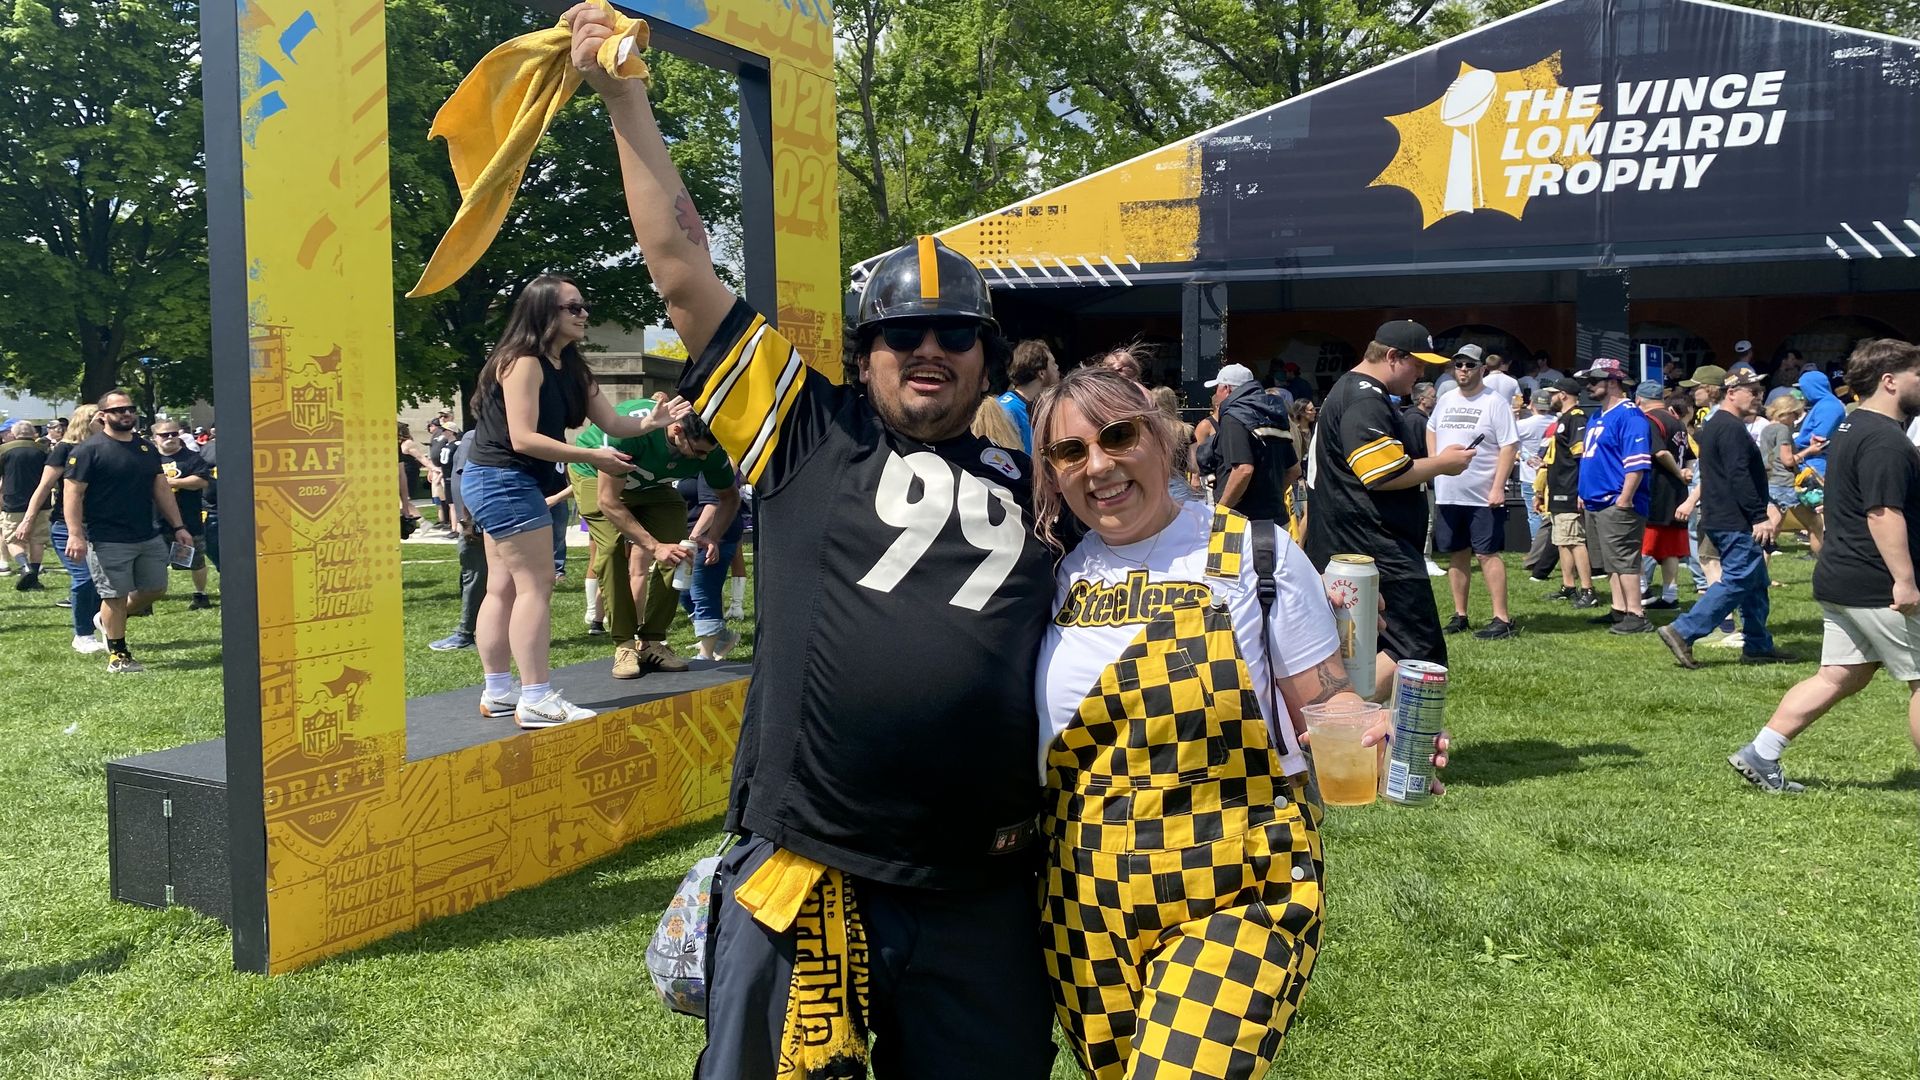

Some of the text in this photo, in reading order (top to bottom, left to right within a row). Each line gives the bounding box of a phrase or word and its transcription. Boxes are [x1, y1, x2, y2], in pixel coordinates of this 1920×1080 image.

[1504, 70, 1786, 122] THE VINCE
[1501, 109, 1787, 161] LOMBARDI
[1504, 153, 1717, 197] TROPHY
[295, 404, 325, 427] NFL
[1445, 407, 1483, 415] UNDER
[1439, 422, 1476, 430] ARMOUR
[298, 486, 327, 497] 2026
[856, 451, 1027, 612] 99
[1331, 579, 1359, 594] STELLA
[306, 729, 336, 753] NFL
[605, 732, 623, 753] NFL
[265, 763, 376, 812] DRAFT
[308, 811, 337, 825] 2026
[327, 856, 368, 881] PICK
[327, 883, 368, 907] PICK
[826, 888, 837, 919] The
[328, 909, 368, 939] PICK
[797, 872, 844, 1047] errible
